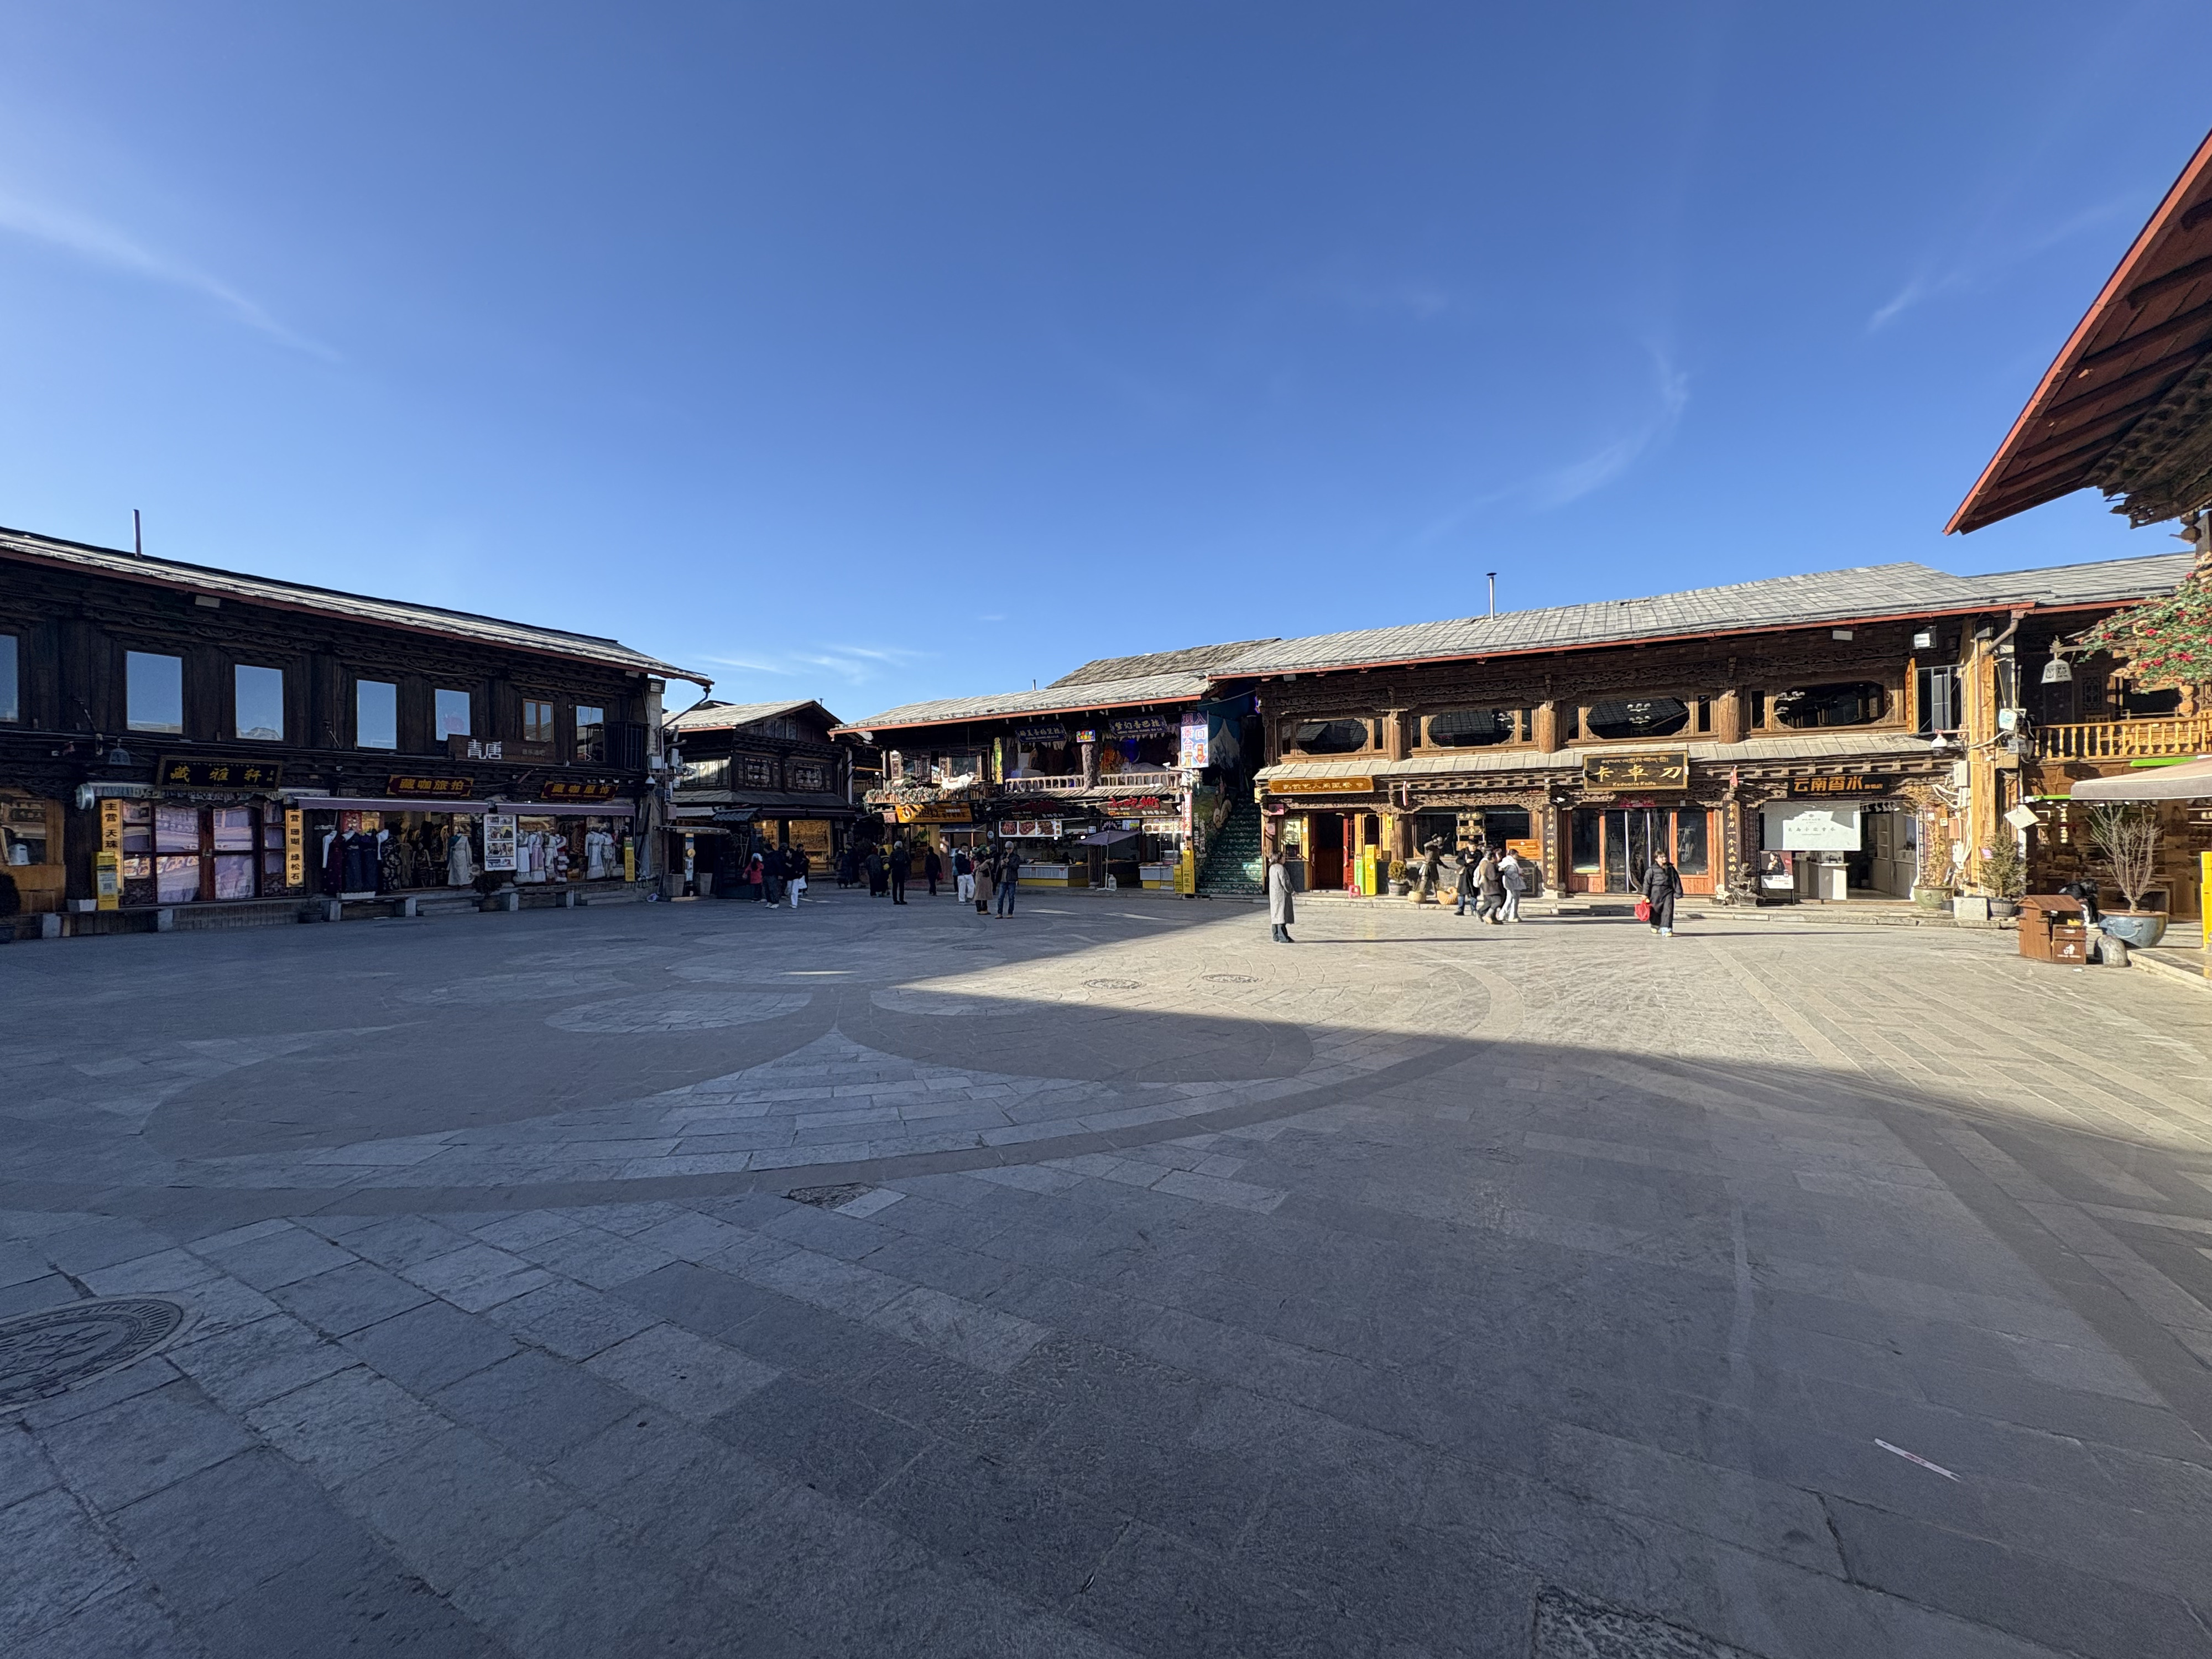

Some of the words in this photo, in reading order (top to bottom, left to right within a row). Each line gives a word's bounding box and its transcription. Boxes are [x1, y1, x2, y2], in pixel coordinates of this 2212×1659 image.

[1182, 713, 1194, 750] 观景台
[1194, 713, 1207, 740] 入口
[170, 765, 262, 783] 藏雅轩
[1589, 764, 1682, 782] 卡卓刀
[399, 779, 465, 791] 藏咖旅拍
[1794, 775, 1864, 792] 云南香水
